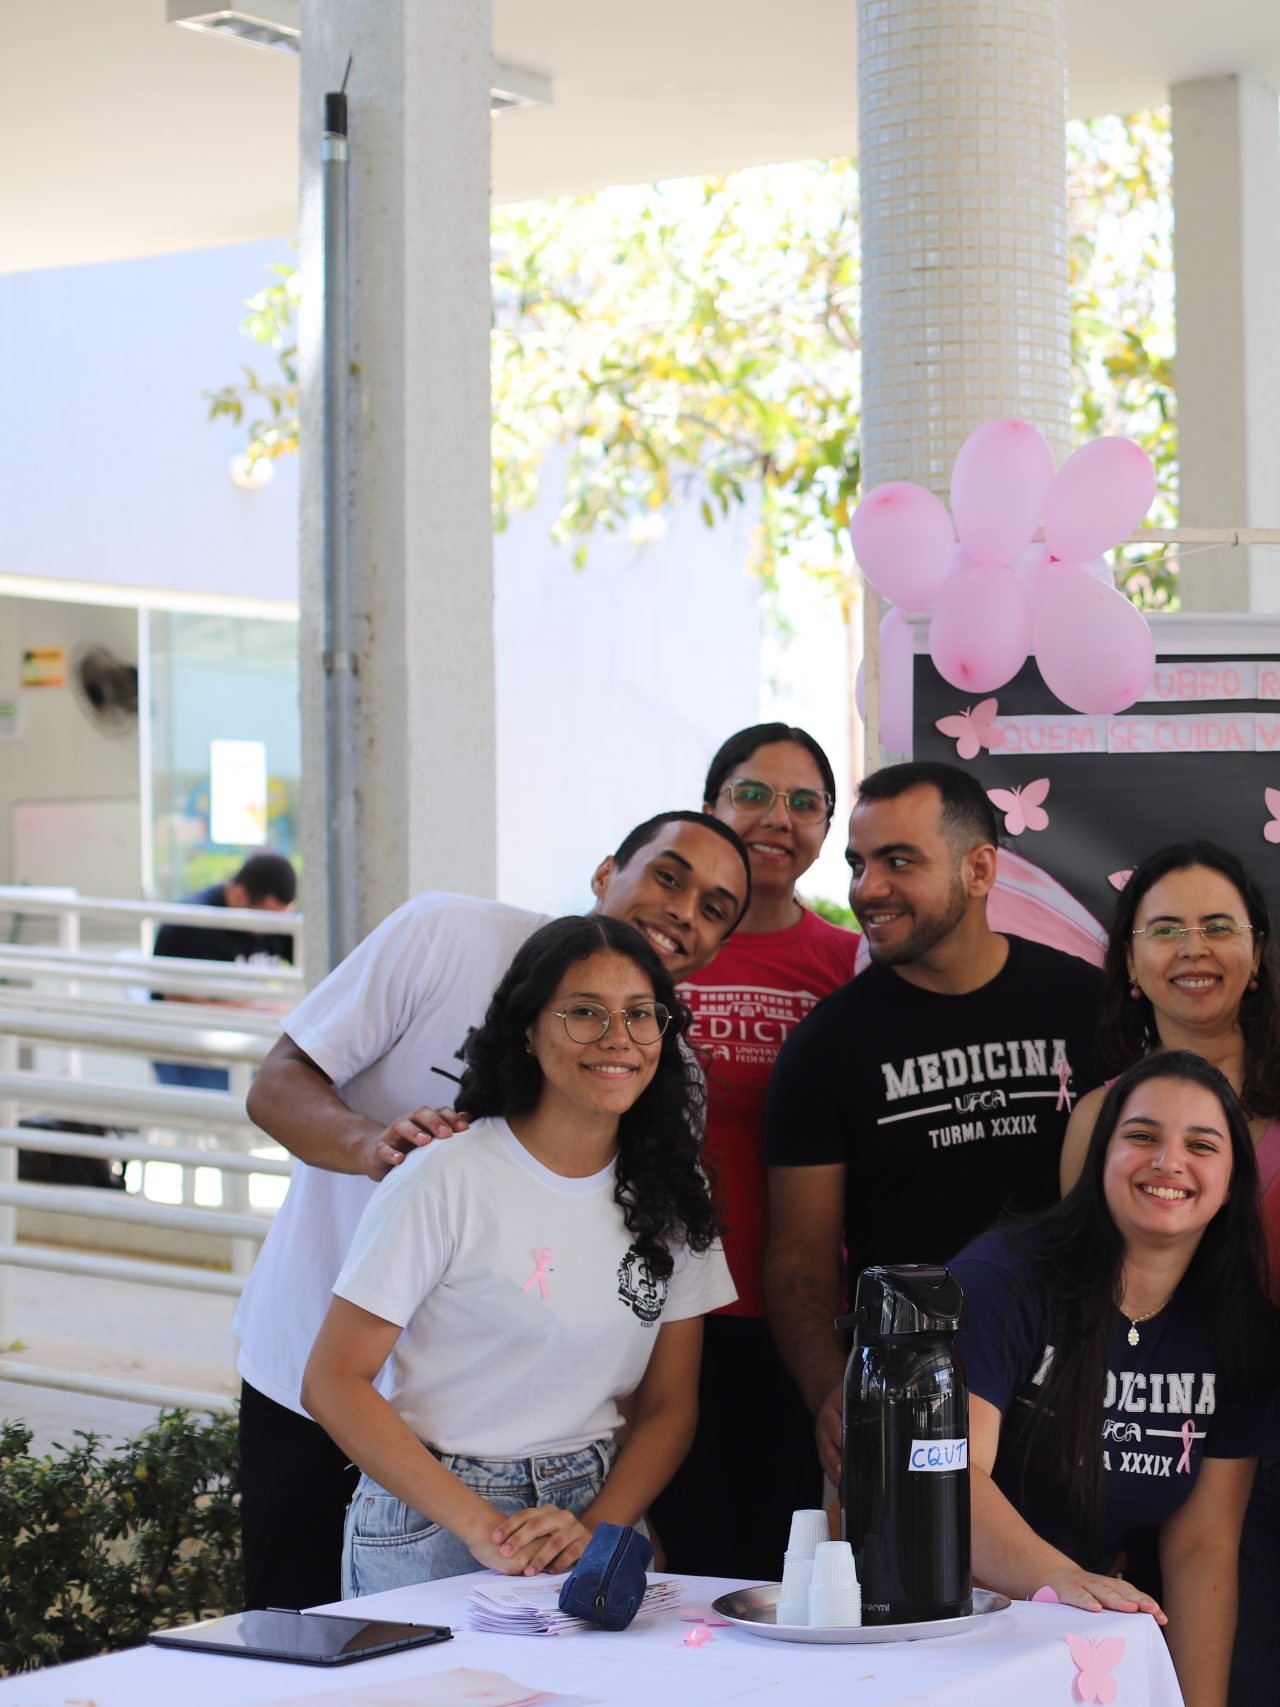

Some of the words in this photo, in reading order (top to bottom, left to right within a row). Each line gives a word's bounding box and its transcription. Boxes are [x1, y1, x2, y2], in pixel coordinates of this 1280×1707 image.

[1153, 668, 1241, 699] UBRO
[1001, 722, 1097, 752] QUEM
[1109, 721, 1143, 751] SE
[1154, 720, 1246, 751] CUIDA
[688, 1014, 788, 1043] EDICI
[735, 1046, 779, 1057] UNIVERS
[735, 1055, 777, 1064] FEDERA
[880, 1039, 1073, 1102] MEDICINA
[954, 1089, 1007, 1114] UFCA
[928, 1121, 986, 1149] TURMA
[991, 1114, 1038, 1137] XXXIX
[1119, 1451, 1173, 1477] XXXIX
